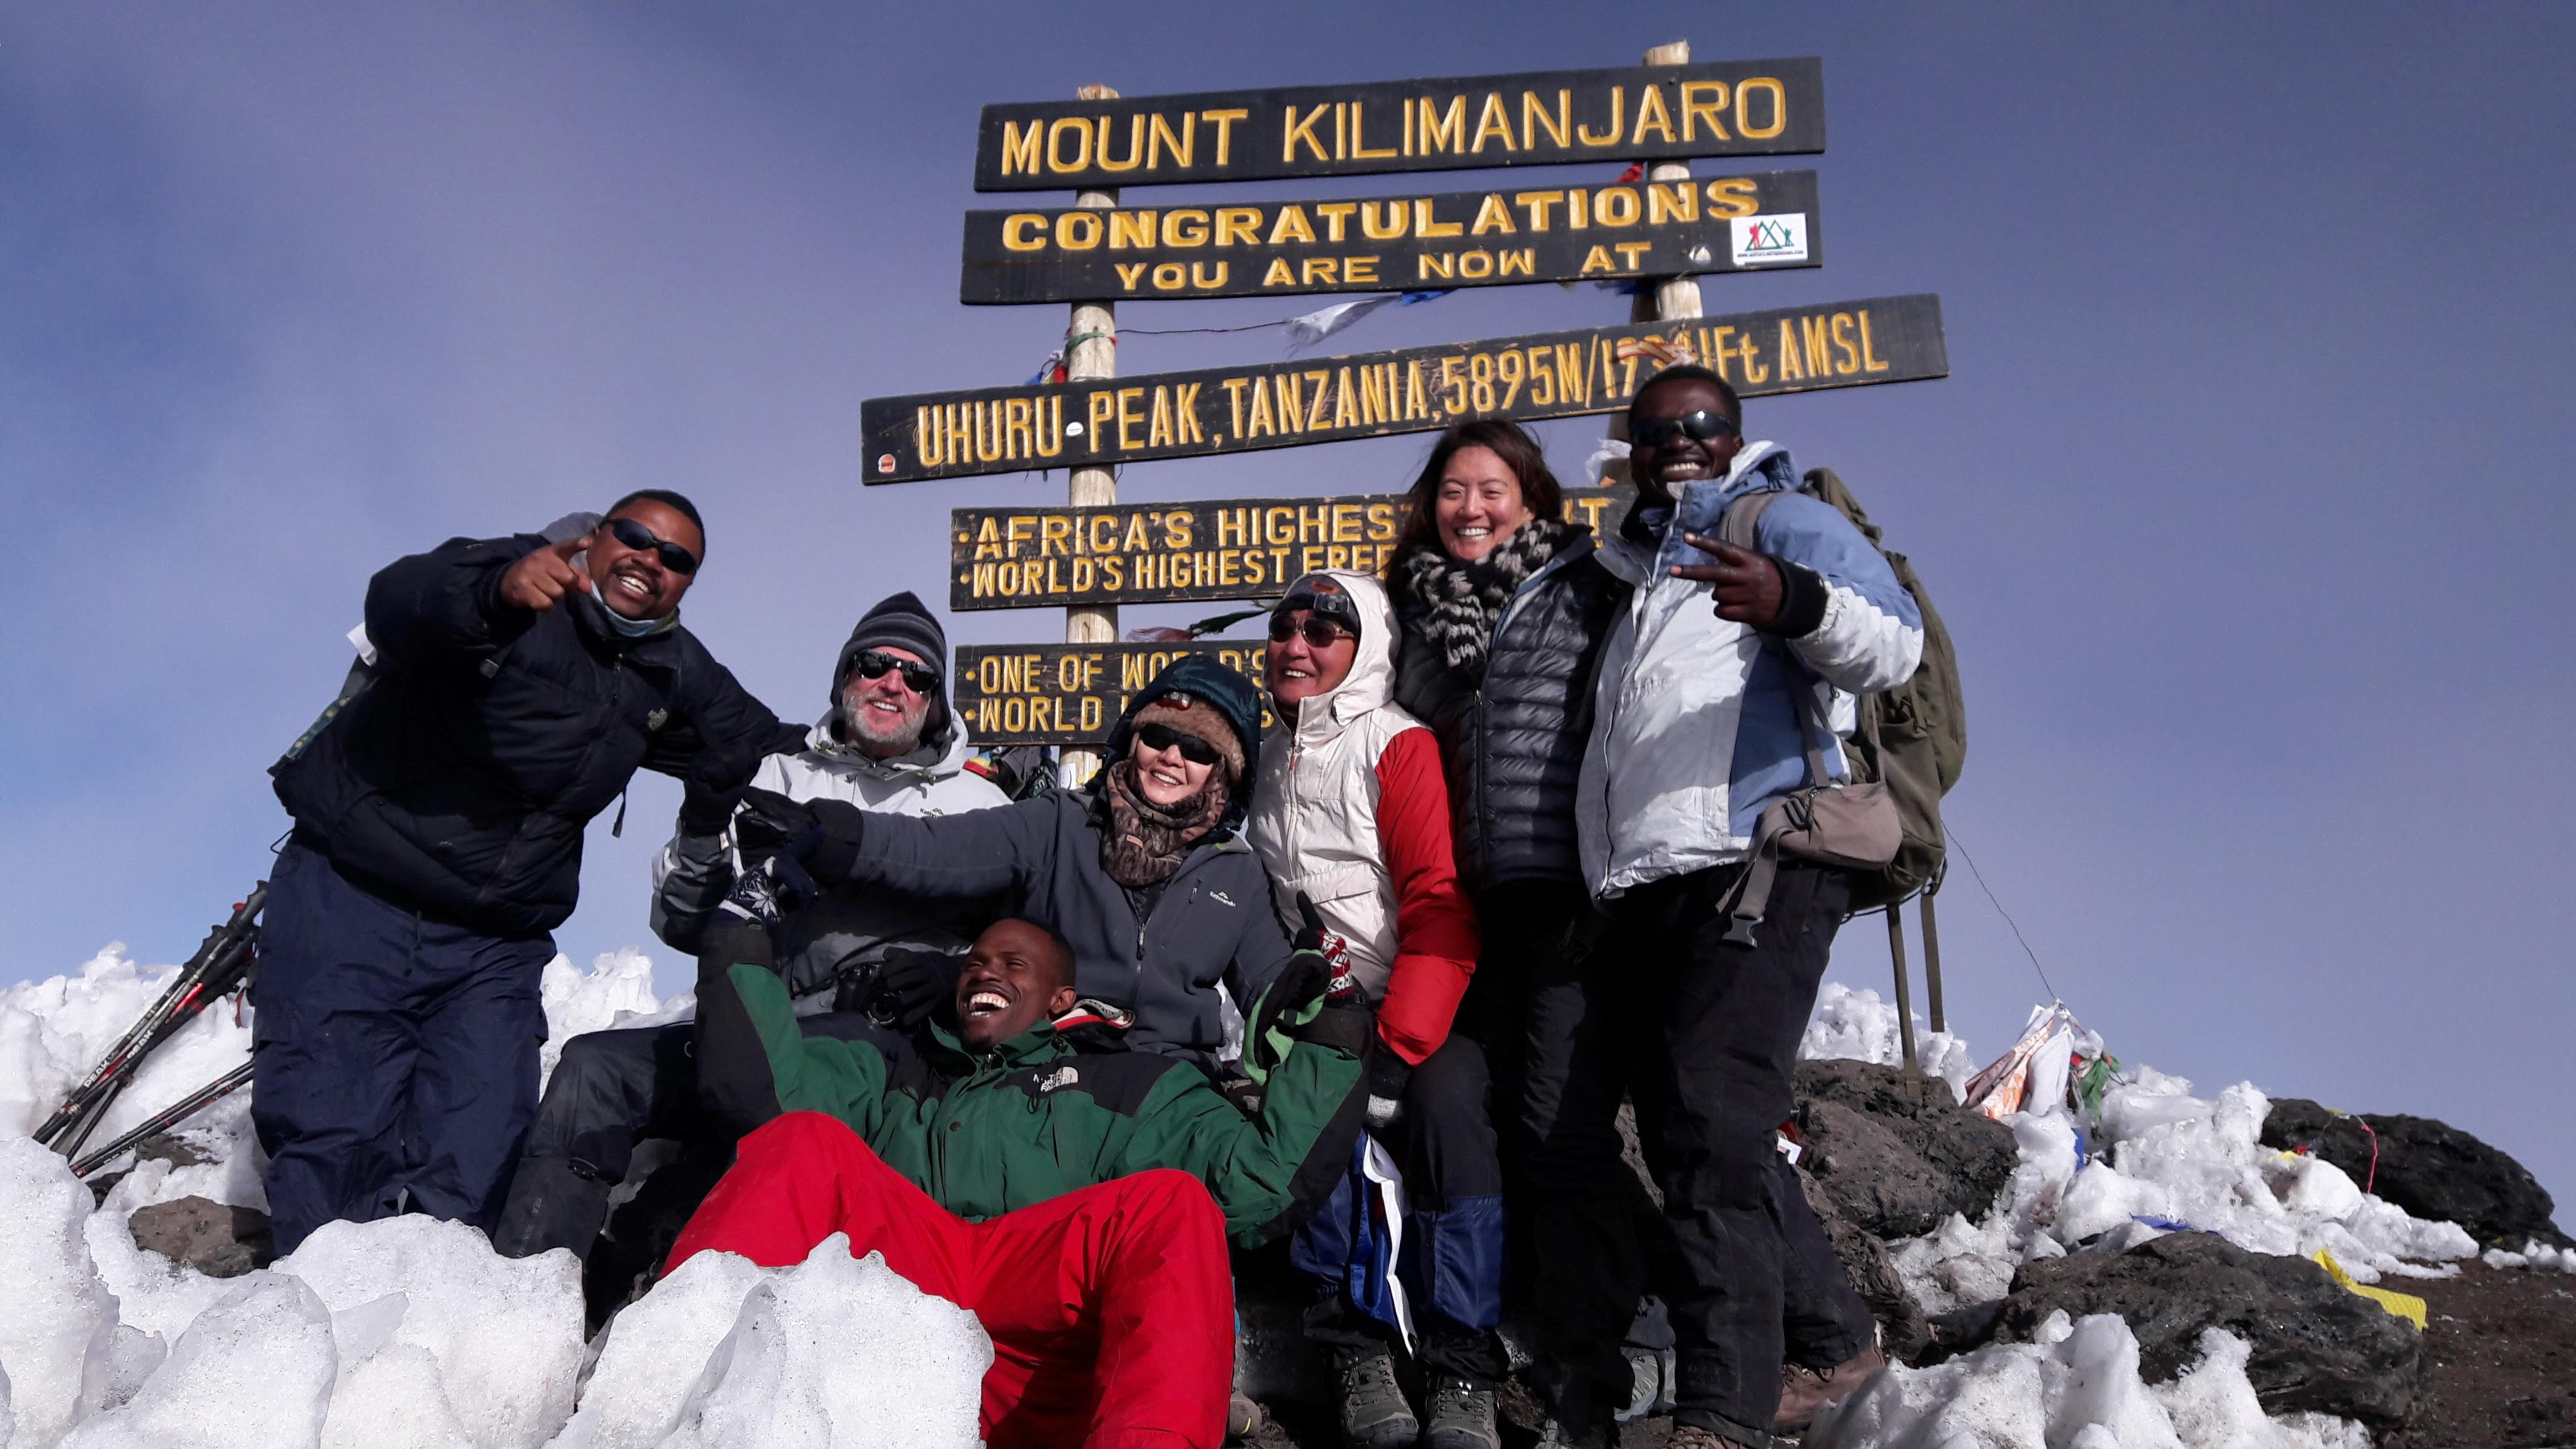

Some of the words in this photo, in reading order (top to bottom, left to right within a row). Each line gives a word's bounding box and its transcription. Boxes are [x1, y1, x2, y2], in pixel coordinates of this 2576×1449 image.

[1002, 109, 1249, 176] MOUNT
[1284, 77, 1787, 162] KILIMANJARO
[1002, 178, 1759, 252] CONGRATULATIONS
[1115, 260, 1229, 291] YOU
[1263, 256, 1380, 287] ARE
[1418, 249, 1536, 280] NOW
[1581, 241, 1652, 274] AT
[918, 394, 1063, 467] UHURU
[1780, 310, 1888, 381] AMSL
[974, 510, 1194, 560] AFRICA'S
[972, 555, 1125, 598] WORLD'S
[1134, 547, 1292, 590] HIGHEST
[980, 654, 1042, 695] ONE
[1058, 653, 1103, 693] OF
[980, 696, 1104, 733] WORLD
[83, 1059, 110, 1088] PEAK
